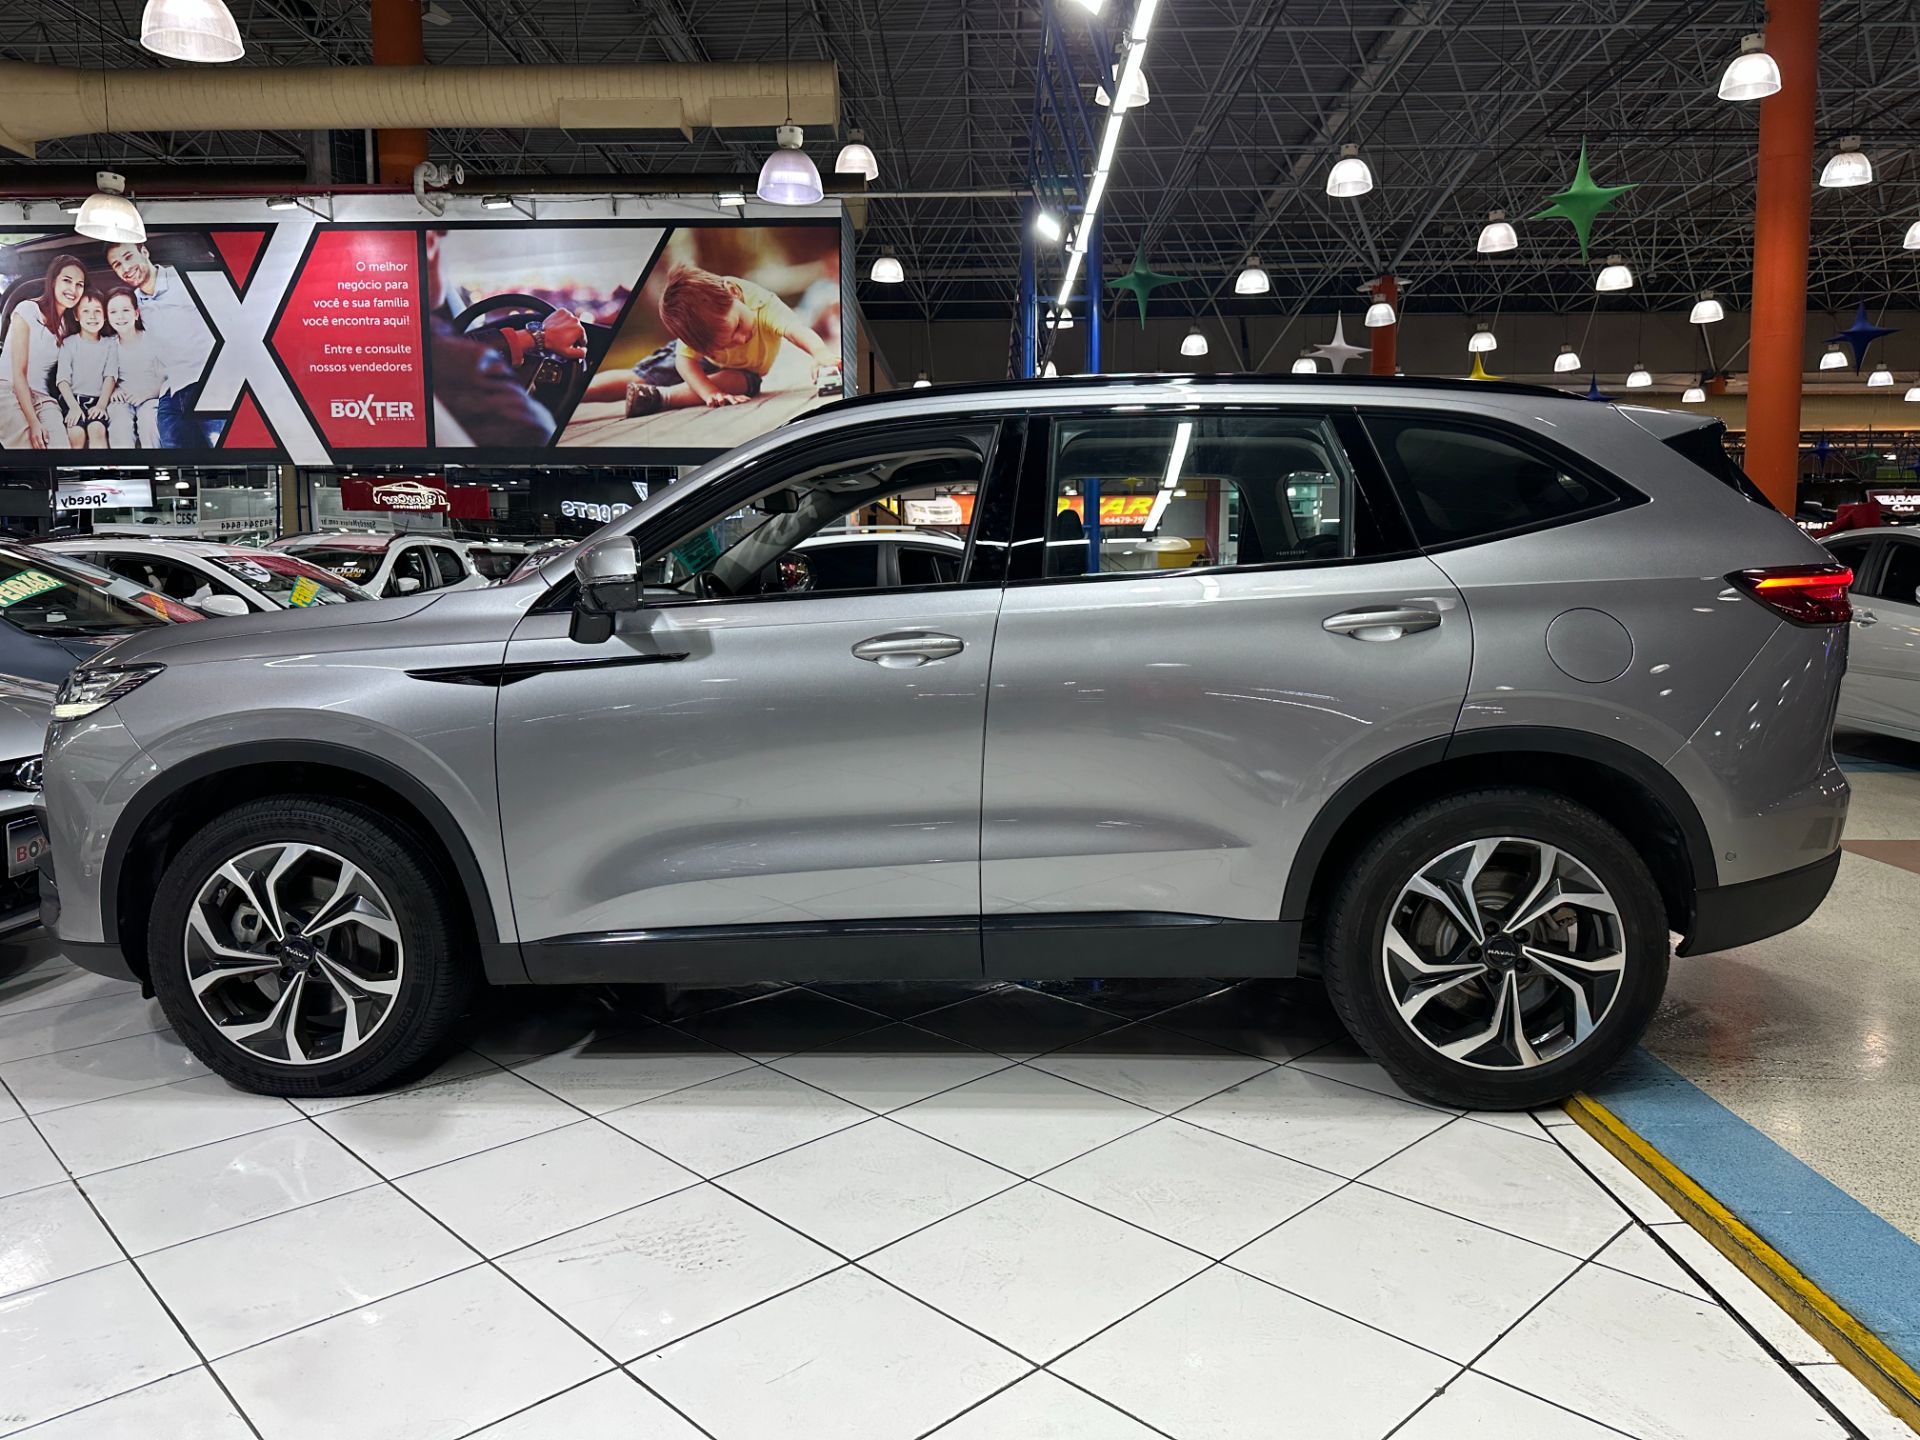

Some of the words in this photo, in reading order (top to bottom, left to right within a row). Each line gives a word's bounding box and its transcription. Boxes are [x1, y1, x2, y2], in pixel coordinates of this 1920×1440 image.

[356, 262, 366, 272] O
[369, 261, 408, 272] melhor
[337, 280, 382, 292] negócio
[385, 281, 409, 292] para
[313, 298, 339, 308] você
[342, 300, 349, 308] e
[351, 300, 370, 308] sua
[373, 297, 409, 308] família
[302, 316, 328, 326] você
[331, 317, 380, 326] encontra
[383, 316, 410, 328] aqui!
[324, 344, 352, 354] Entre
[355, 345, 362, 354] e
[365, 344, 412, 354] consulte
[309, 363, 347, 372] nossos
[349, 362, 413, 372] vendedores
[330, 393, 415, 426] BOXTER
[1487, 949, 1516, 957] HAVAL
